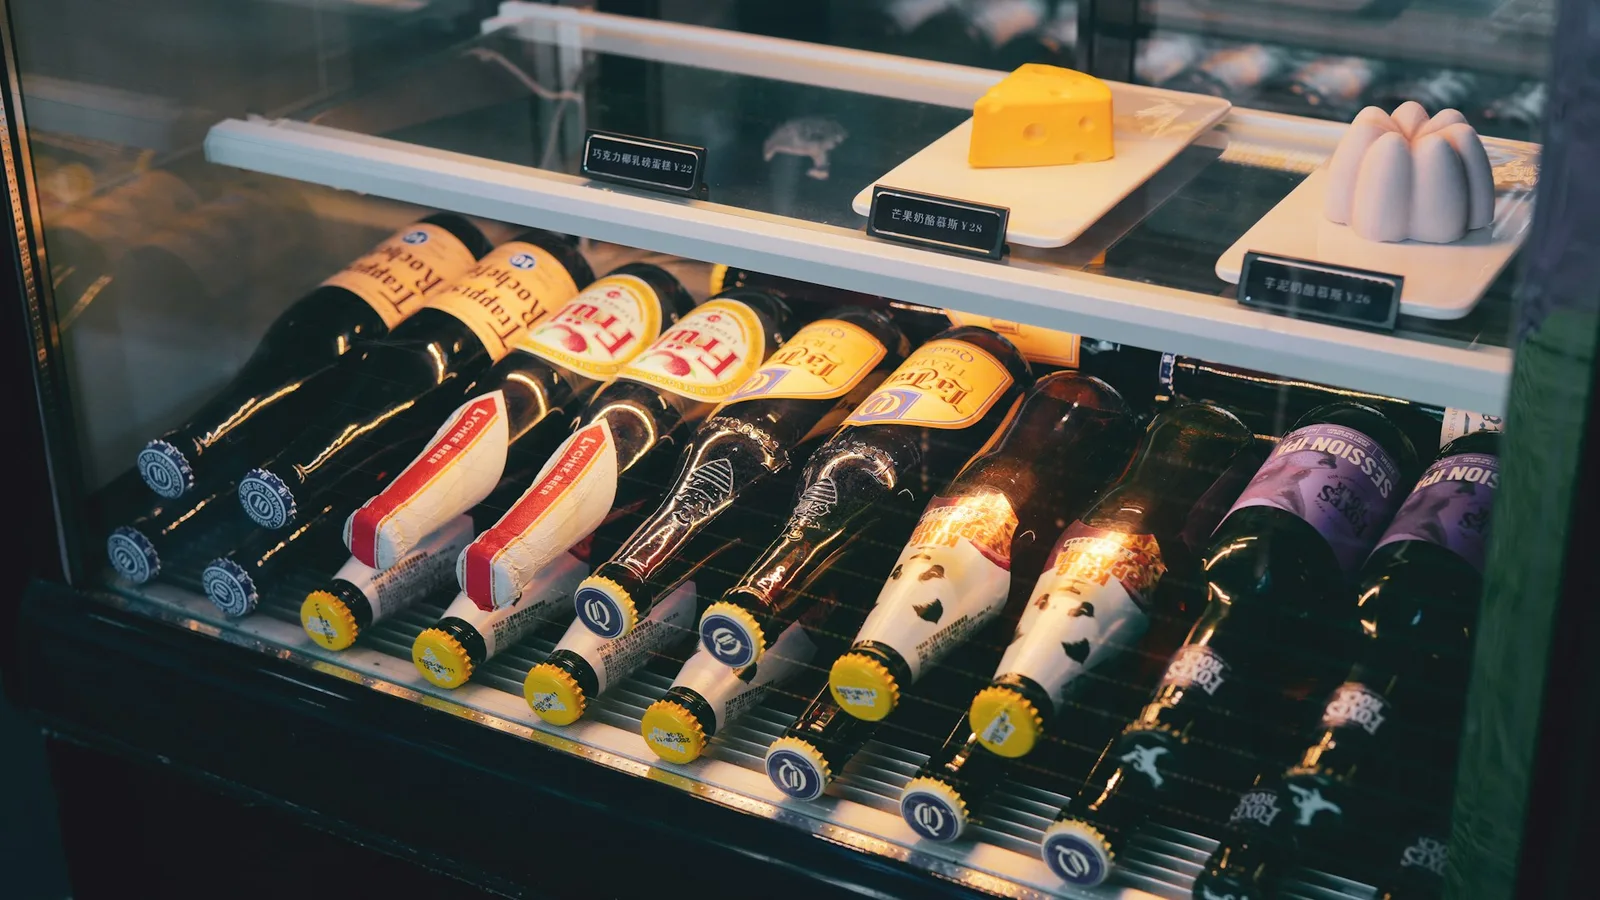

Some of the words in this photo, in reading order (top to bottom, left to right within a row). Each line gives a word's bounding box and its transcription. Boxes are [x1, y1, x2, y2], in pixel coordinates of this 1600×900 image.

[592, 147, 672, 172] 巧克力椰乳磅蛋糕
[891, 207, 958, 231] 芒果奶酪慕斯
[961, 220, 983, 234] ¥28
[450, 407, 488, 444] LYCHEE
[427, 442, 453, 465] BEER
[558, 435, 597, 473] LYCHEE
[1276, 436, 1311, 456] IPA
[152, 466, 167, 483] 10
[1309, 435, 1393, 499] SESSION
[538, 471, 565, 496] BEER
[253, 495, 270, 514] 10
[584, 598, 611, 632] Q
[712, 627, 742, 656] Q
[779, 758, 807, 792] Q
[914, 802, 945, 837] Q
[1055, 844, 1091, 878] Q
